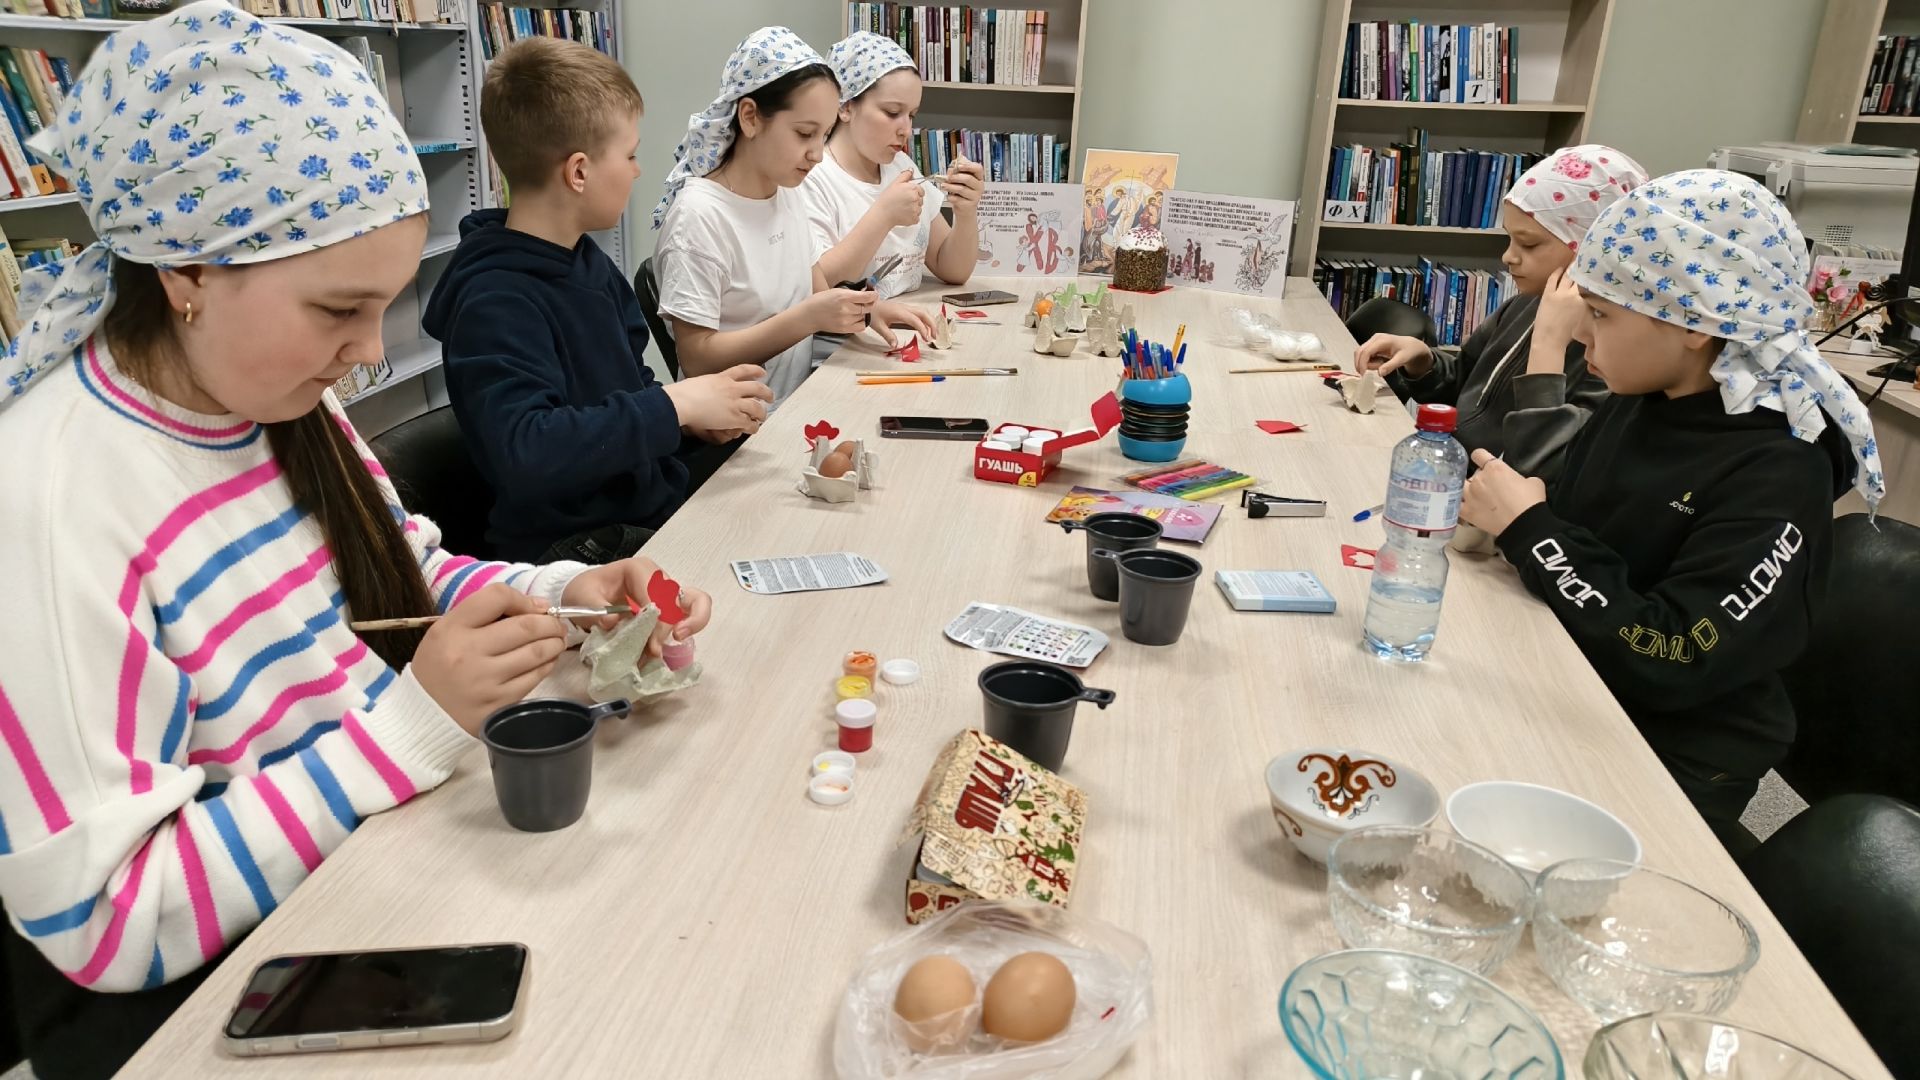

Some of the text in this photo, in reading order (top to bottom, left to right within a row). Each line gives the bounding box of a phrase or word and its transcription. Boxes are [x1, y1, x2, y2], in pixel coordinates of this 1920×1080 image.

[1328, 204, 1343, 217] Ф
[979, 457, 1024, 474] ГУАШЬ
[955, 750, 1016, 834] ГУАШЬ
